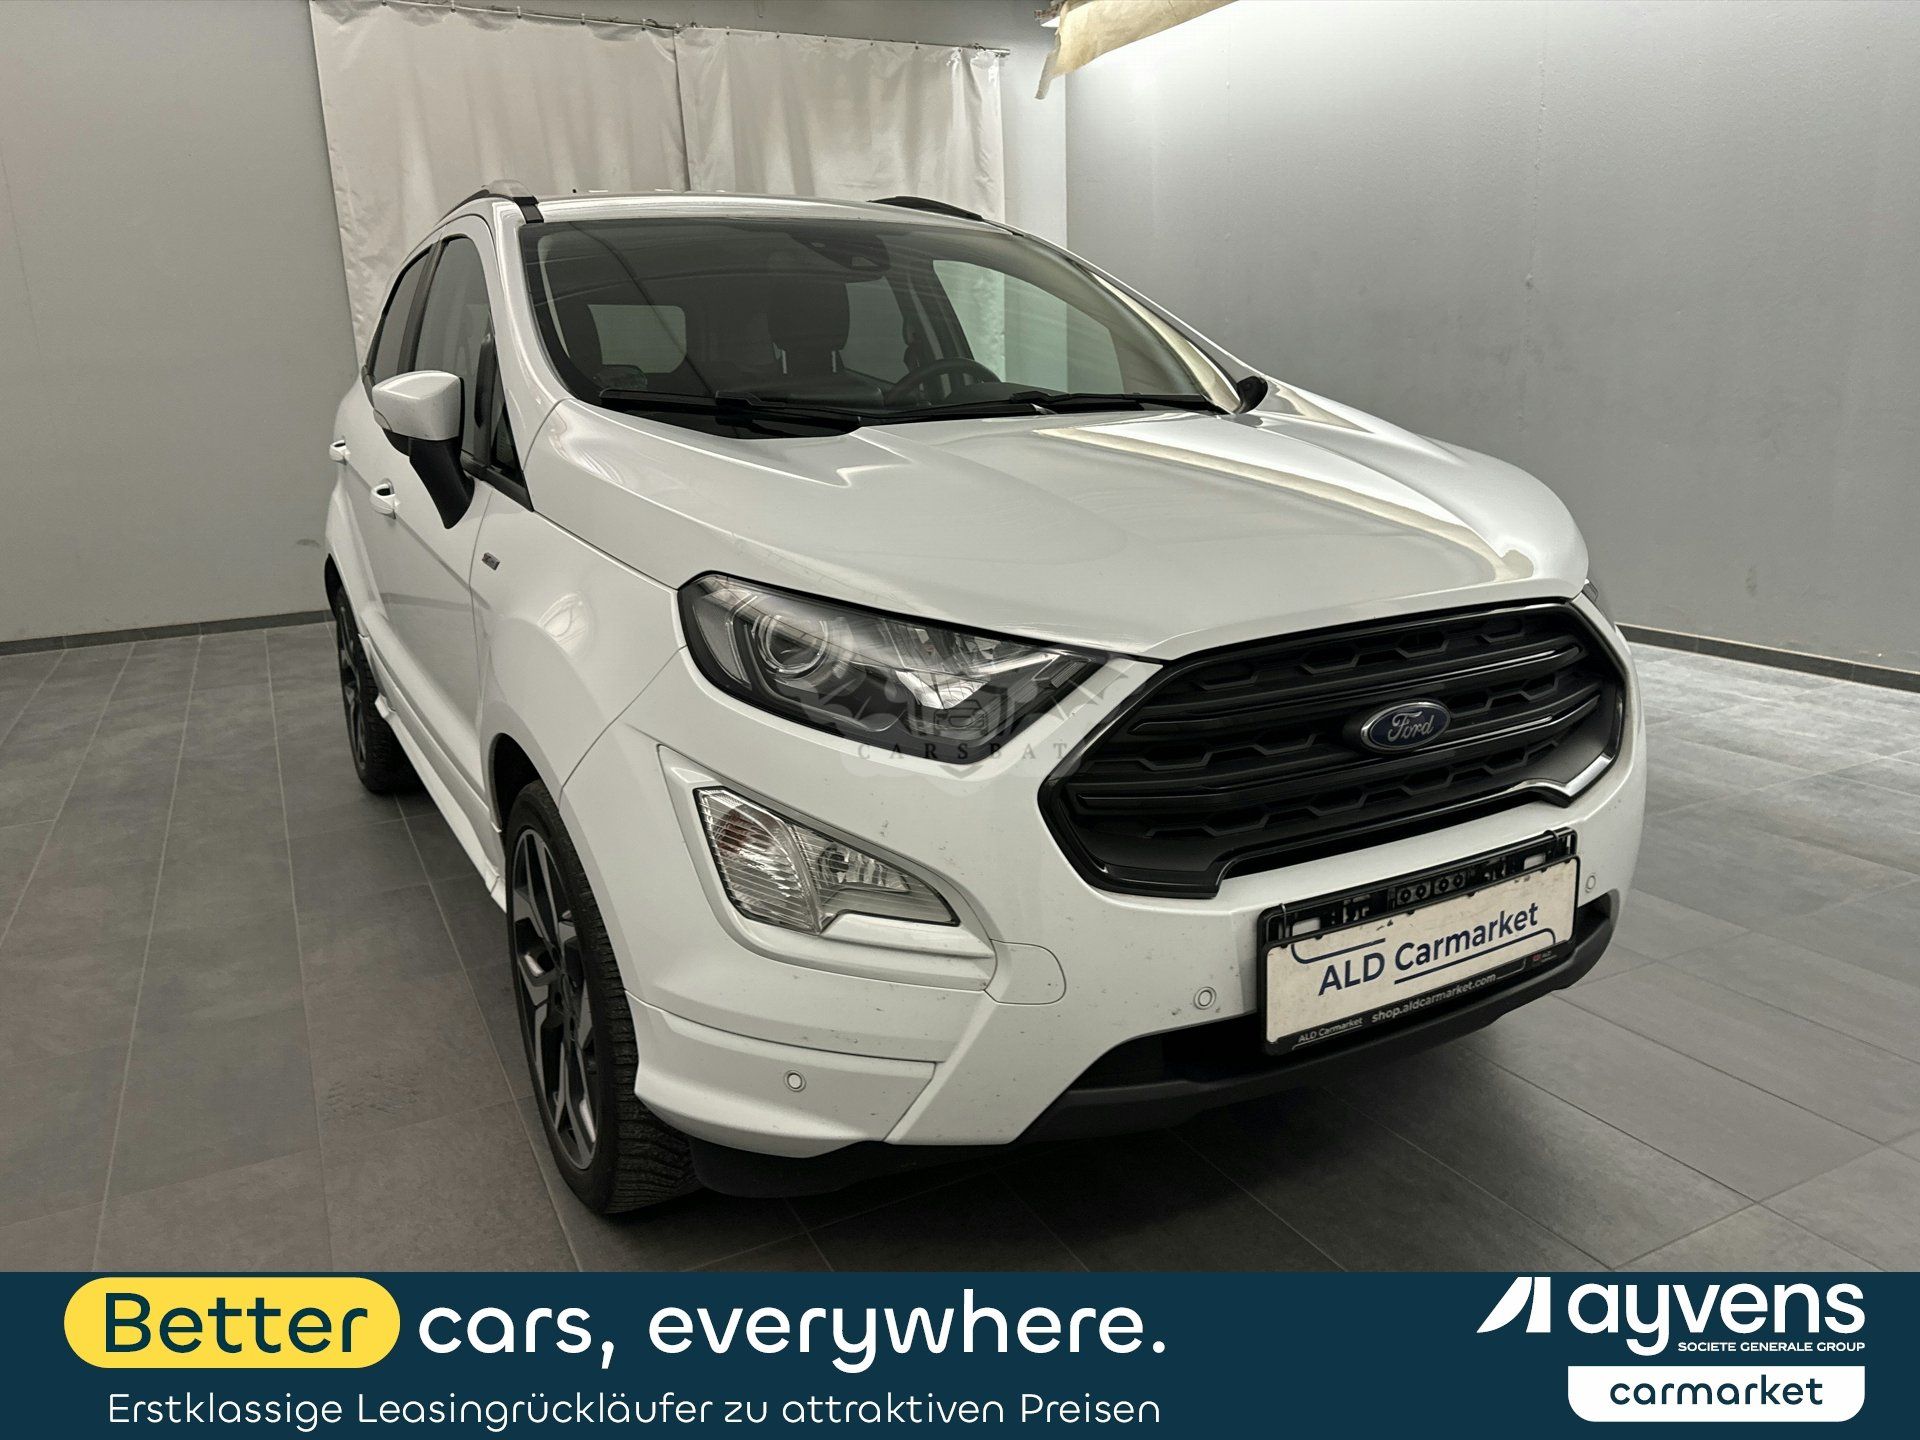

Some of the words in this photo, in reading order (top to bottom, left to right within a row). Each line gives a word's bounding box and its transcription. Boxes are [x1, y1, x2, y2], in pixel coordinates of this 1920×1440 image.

[1387, 711, 1435, 742] Ford
[1318, 952, 1386, 996] ALD
[1395, 903, 1539, 971] Carmarket
[1371, 974, 1496, 1023] shop.aldcarmarket.com
[1298, 1031, 1317, 1043] ALD
[1318, 1016, 1364, 1037] Carmarket
